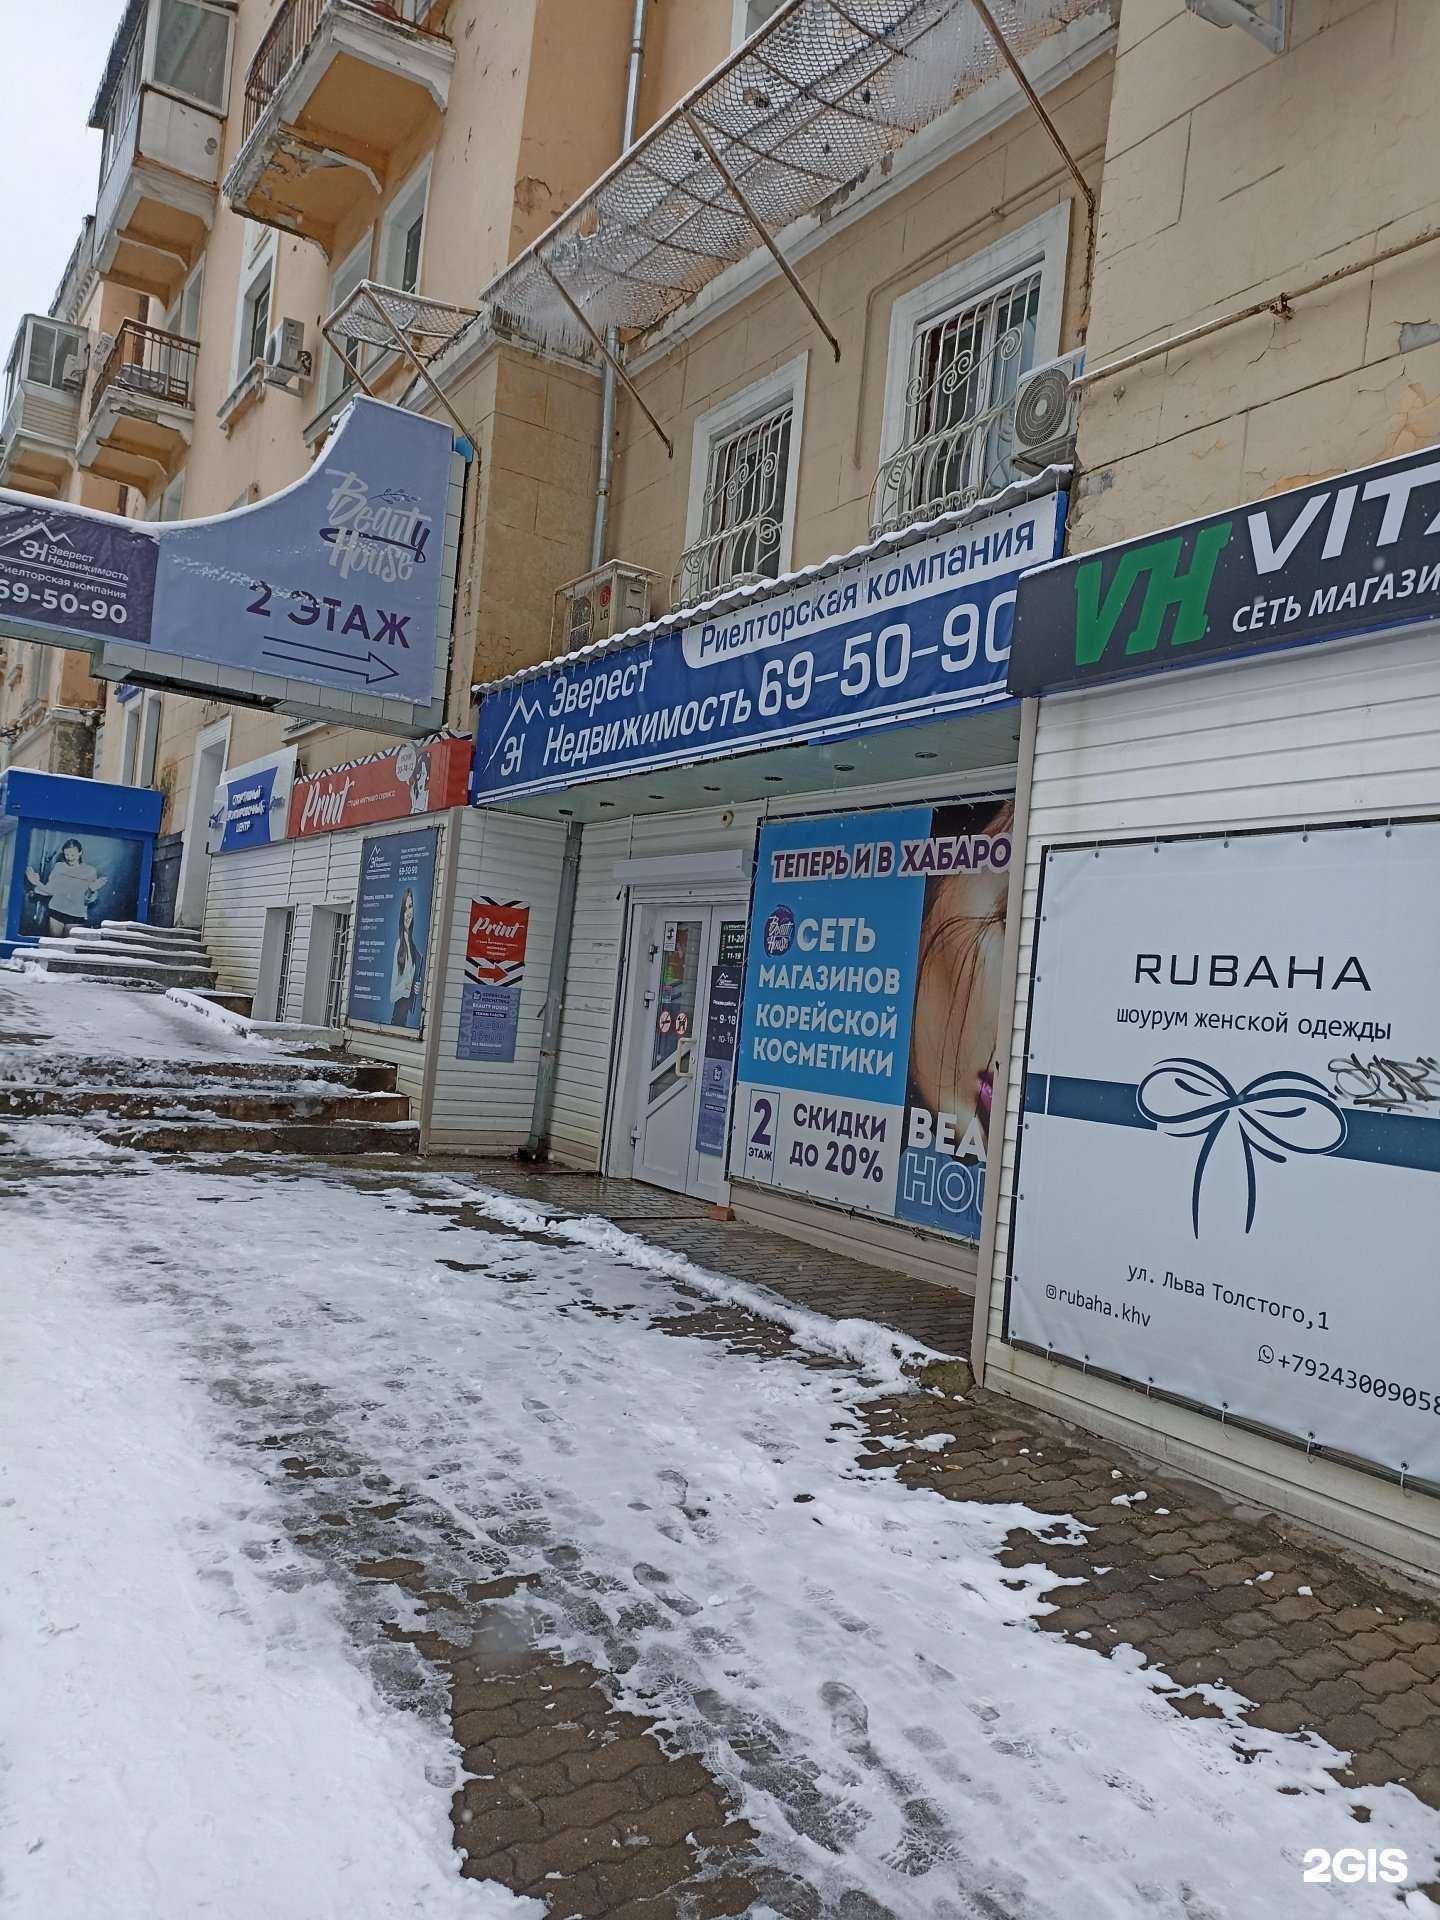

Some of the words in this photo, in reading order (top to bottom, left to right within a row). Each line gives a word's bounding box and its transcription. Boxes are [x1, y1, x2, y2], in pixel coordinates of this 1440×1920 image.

[322, 468, 432, 562] Beauty
[1248, 462, 1440, 575] VIT
[47, 553, 129, 581] Недвижимость
[48, 544, 95, 563] Эверест
[329, 526, 416, 583] House
[73, 582, 127, 600] компания
[700, 582, 857, 658] Риелторская
[868, 519, 1036, 604] компания
[1074, 521, 1234, 667] VH
[246, 580, 272, 617] 2
[287, 590, 412, 649] ЭТАЖ
[1232, 595, 1303, 633] СЕТЬ
[758, 589, 1018, 717] 69-50-90
[549, 659, 653, 718] Эверест
[542, 687, 752, 768] Недвижимость
[300, 776, 356, 833] Print
[773, 849, 849, 879] ТЕПЕРЬ
[854, 846, 872, 875] И
[876, 845, 893, 873] В
[901, 837, 1012, 873] ХАБАРО
[471, 917, 526, 939] Print
[796, 917, 876, 952] СЕТЬ
[758, 964, 901, 995] МАГАЗИНОВ
[1135, 953, 1373, 992] RUBAHA
[755, 1000, 899, 1040] КОРЕЙСКОЙ
[1116, 1007, 1189, 1031] шоурум
[1194, 1011, 1289, 1034] женской
[1297, 1017, 1393, 1042] одежды
[752, 1037, 894, 1078] КОСМЕТИКИ
[751, 1098, 772, 1146] 2
[793, 1103, 887, 1143] СКИДКИ
[908, 1106, 988, 1162] BEA
[748, 1146, 773, 1162] ЭТАЖ
[789, 1140, 819, 1168] ДО
[824, 1140, 884, 1183] 20%
[1127, 1264, 1155, 1284] ул.
[1162, 1271, 1205, 1297] Льва
[1212, 1282, 1330, 1331] Толстого,1
